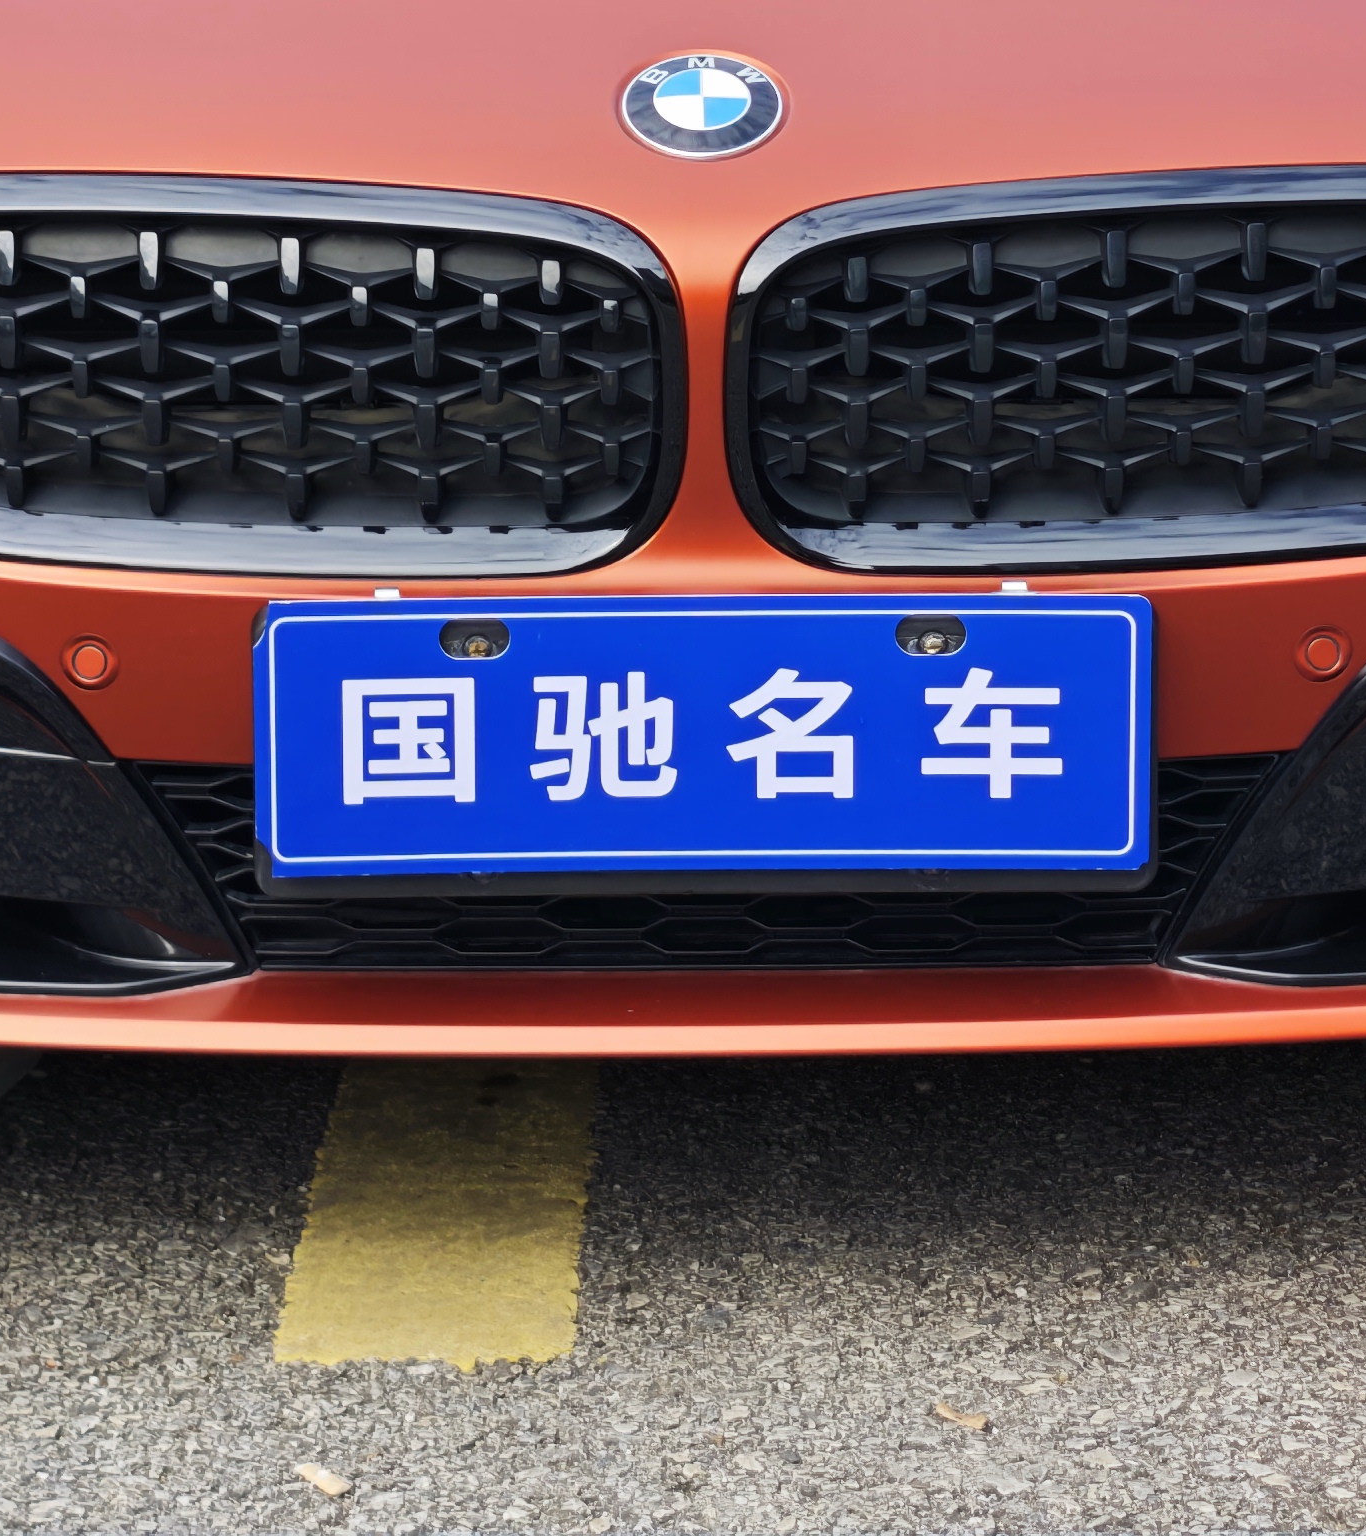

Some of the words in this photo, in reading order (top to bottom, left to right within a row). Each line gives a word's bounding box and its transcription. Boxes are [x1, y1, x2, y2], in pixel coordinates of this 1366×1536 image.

[638, 56, 768, 85] BMW
[340, 667, 1064, 806] 国驰名车
